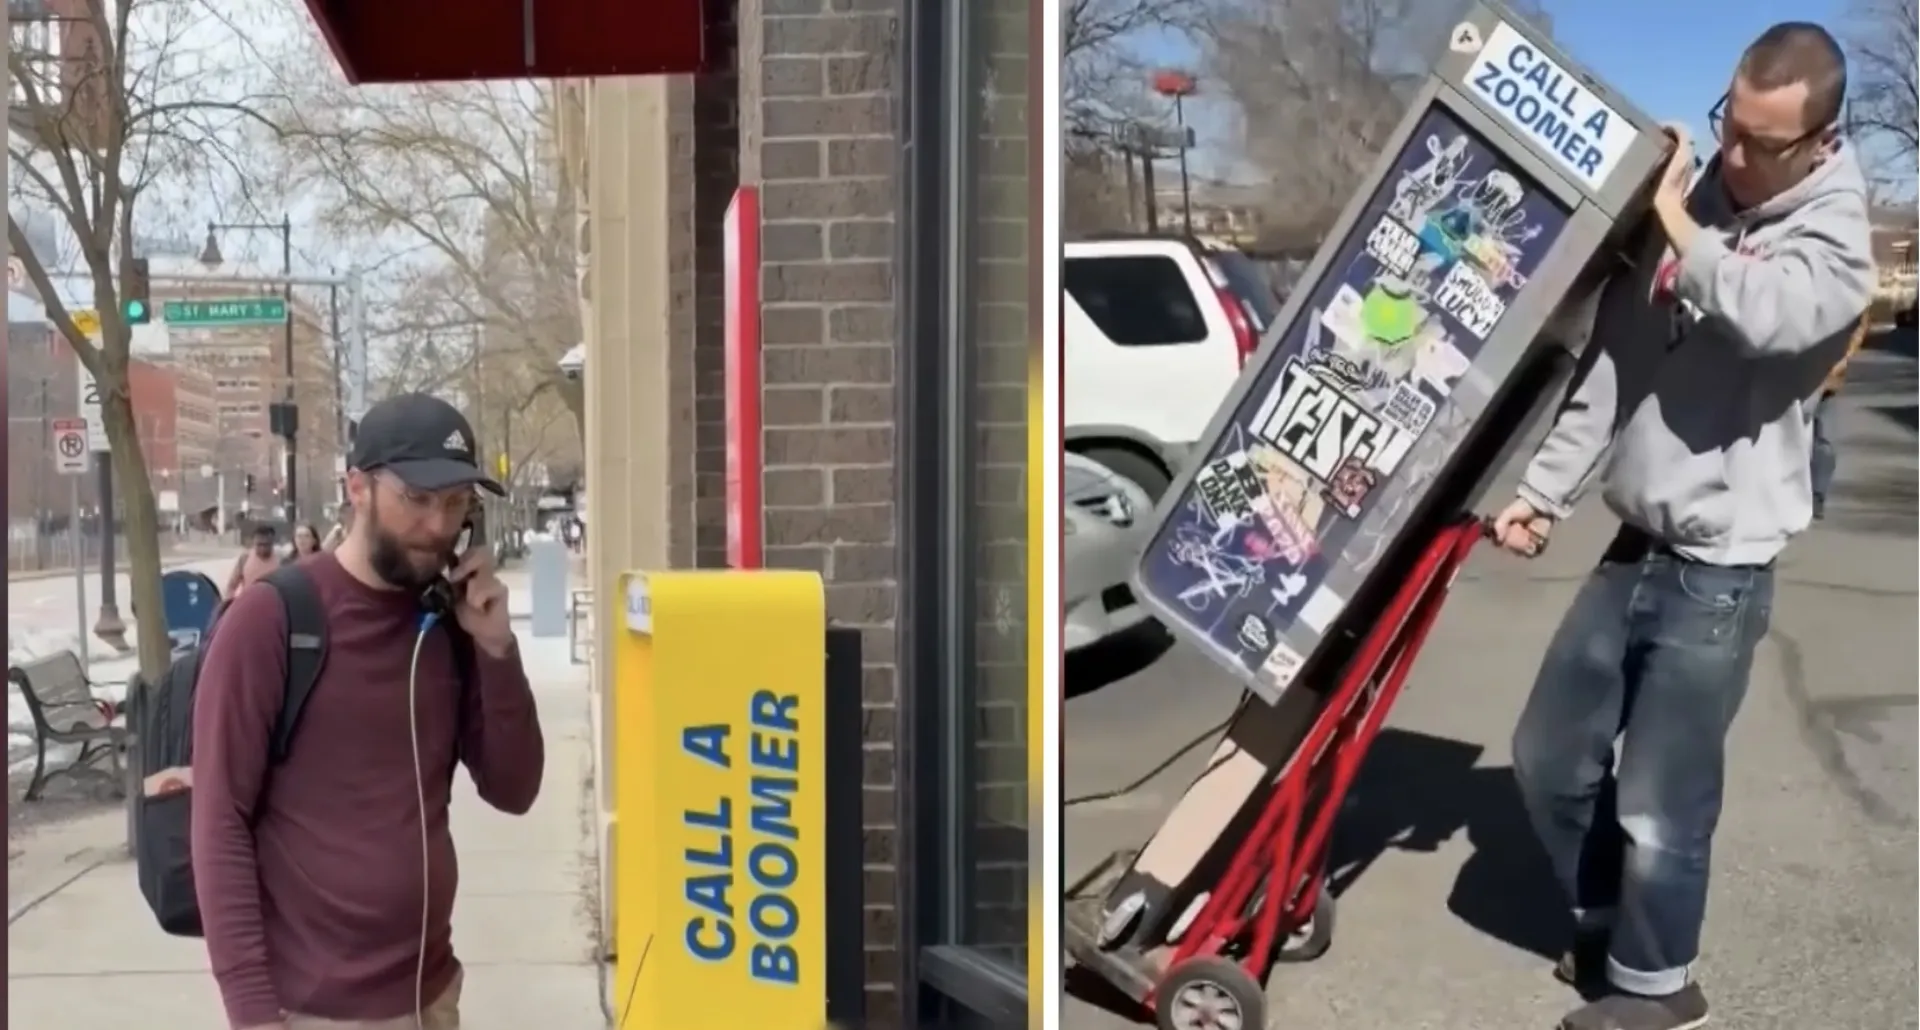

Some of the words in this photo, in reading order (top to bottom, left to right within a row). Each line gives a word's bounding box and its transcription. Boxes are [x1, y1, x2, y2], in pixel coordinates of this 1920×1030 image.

[1474, 61, 1604, 177] ZOOMER
[1507, 44, 1579, 118] CALL
[1583, 108, 1610, 141] A
[208, 303, 248, 317] MARY
[1436, 286, 1492, 332] LUCY!
[1200, 477, 1230, 516] ONE
[1211, 460, 1253, 519] DANK
[683, 723, 732, 768] A
[749, 689, 800, 985] BOOMER
[684, 795, 736, 961] CALL
